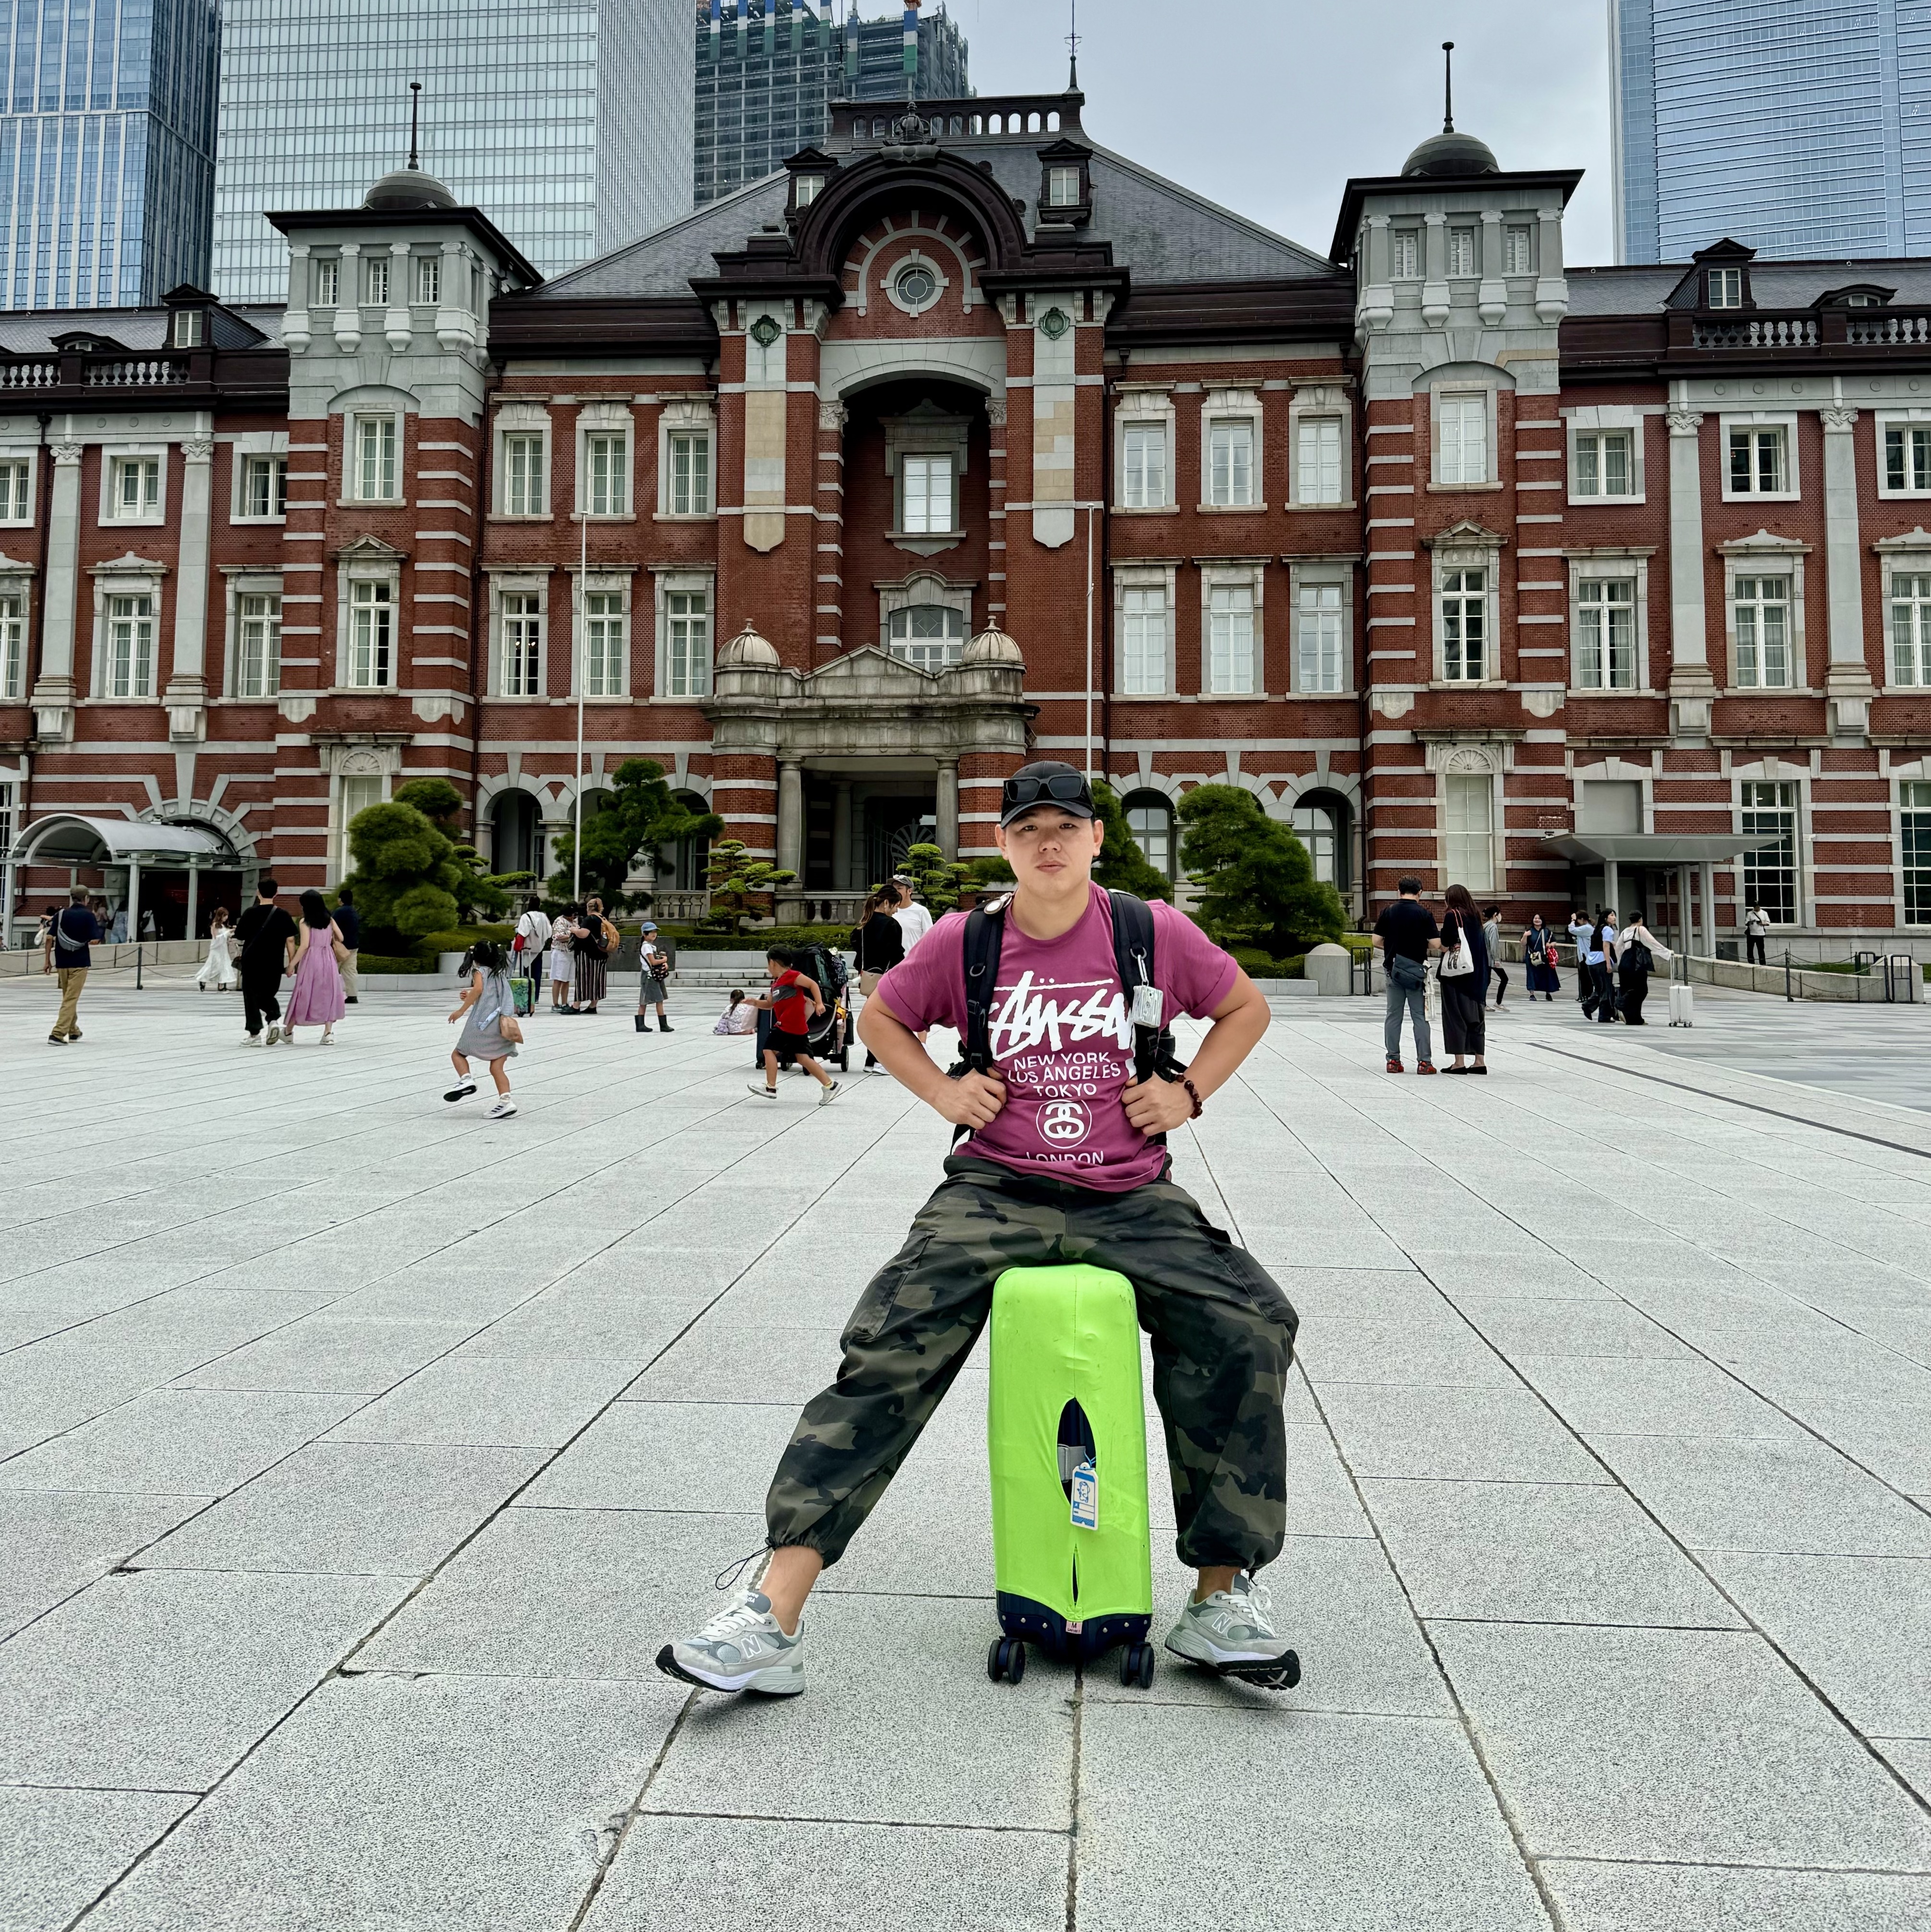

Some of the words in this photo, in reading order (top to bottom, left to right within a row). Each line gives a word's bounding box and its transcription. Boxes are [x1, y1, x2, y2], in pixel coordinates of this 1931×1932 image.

[1014, 1054, 1055, 1071] NEW
[1060, 1052, 1111, 1065] YORK
[1008, 1070, 1039, 1083] LOS
[1043, 1062, 1121, 1082] ANGELES
[1033, 1083, 1097, 1097] TOKYO
[1212, 1612, 1233, 1633] N
[741, 1634, 762, 1658] N
